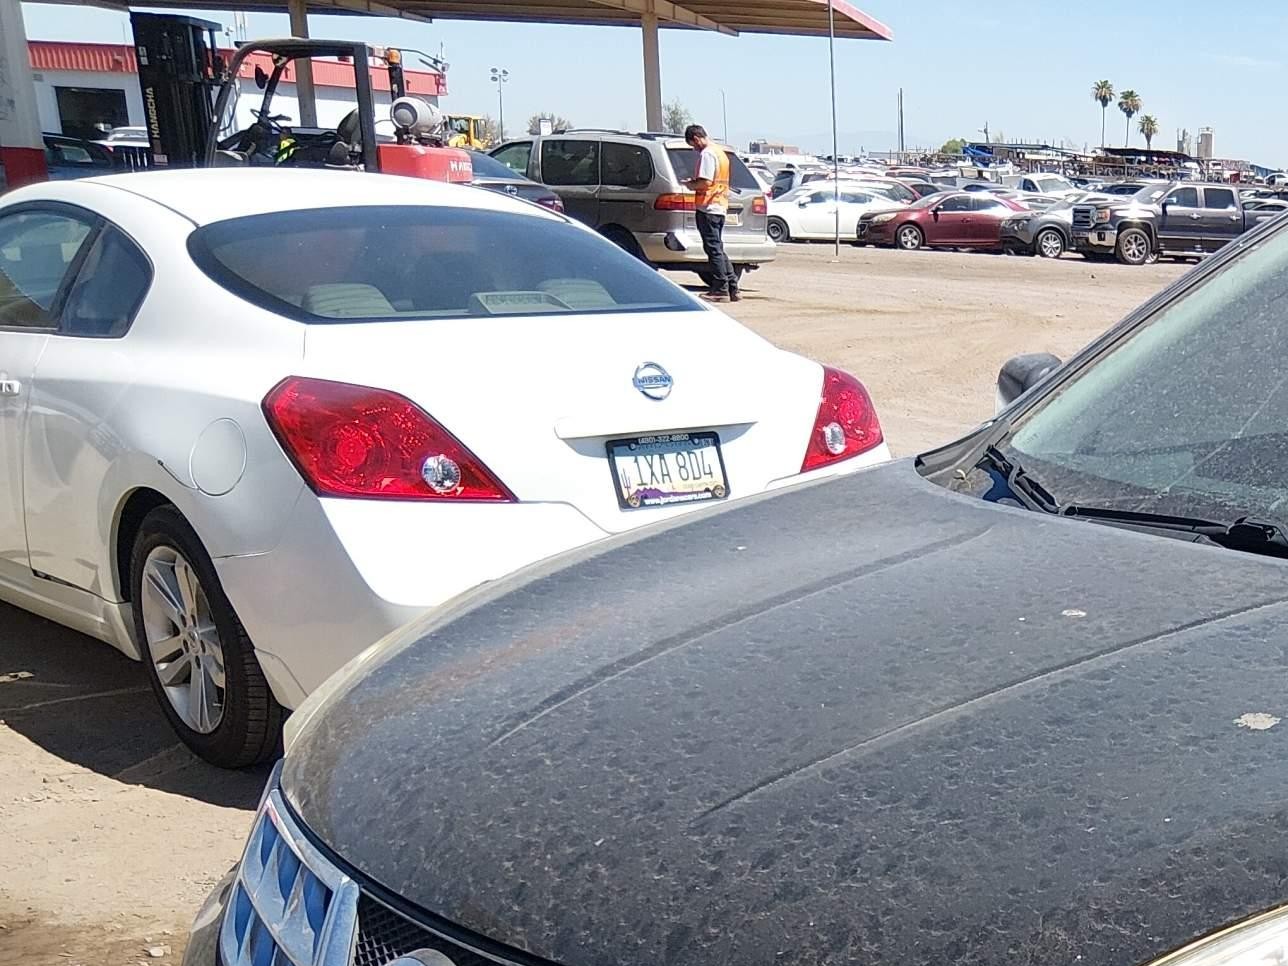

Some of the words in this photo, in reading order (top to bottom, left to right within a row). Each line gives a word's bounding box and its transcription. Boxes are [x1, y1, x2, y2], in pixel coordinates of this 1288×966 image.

[145, 87, 160, 139] HANGCHA
[637, 374, 671, 383] NISSAN
[633, 453, 673, 487] 1XA
[675, 450, 714, 483] 8D4
